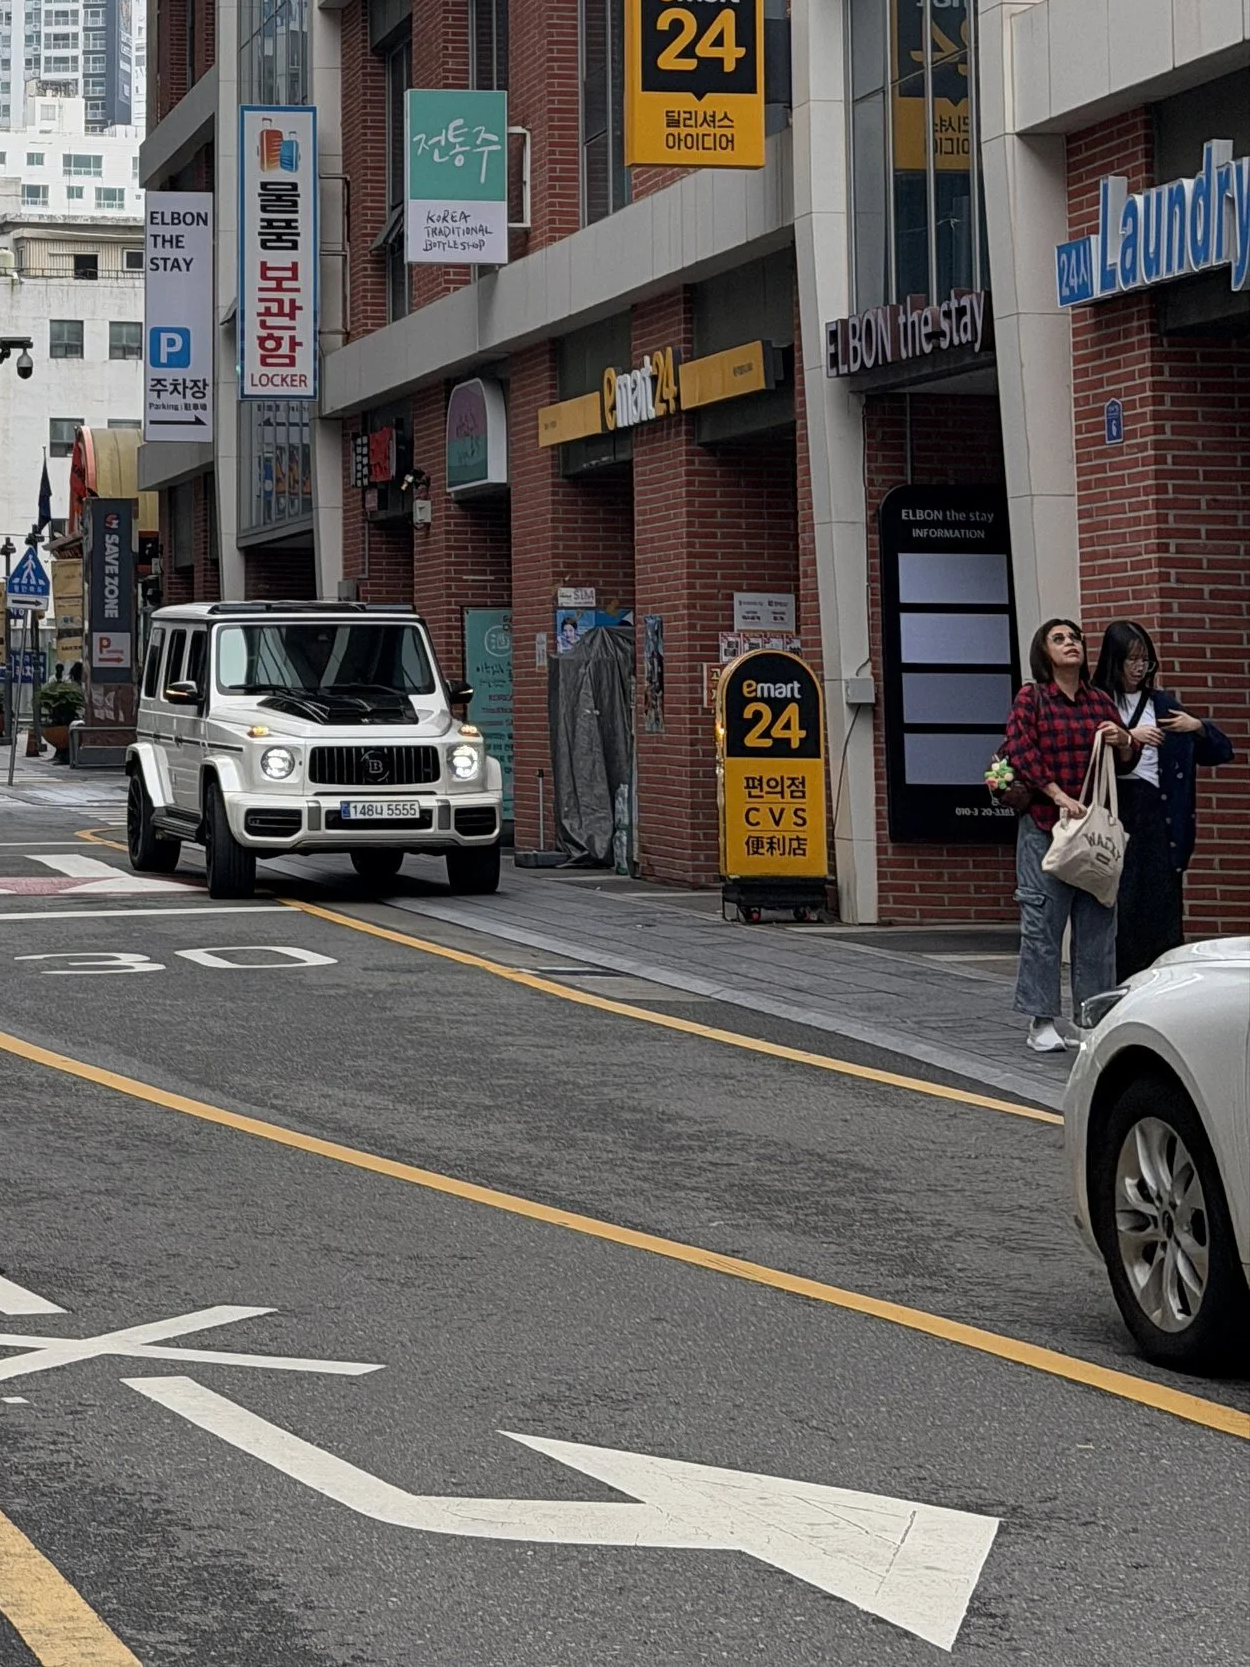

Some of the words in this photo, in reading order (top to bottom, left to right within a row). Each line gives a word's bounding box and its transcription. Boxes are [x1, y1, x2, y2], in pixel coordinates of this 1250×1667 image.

[656, 7, 746, 73] 24
[665, 109, 735, 130] 딜리셔스
[413, 118, 502, 184] 전통주
[665, 133, 735, 152] 아이디어
[150, 210, 209, 226] ELBON
[257, 181, 301, 251] 물품
[426, 209, 471, 224] KOREA
[1059, 240, 1093, 297] 24시
[1099, 139, 1250, 292] Laundry
[150, 233, 186, 249] THE
[424, 225, 493, 238] TRADITIONAL
[149, 257, 194, 272] STAY
[256, 260, 303, 367] 보관함
[825, 303, 892, 378] ELBON
[898, 295, 933, 360] the
[939, 288, 985, 354] stay
[159, 332, 184, 364] P
[149, 377, 209, 400] 주차장
[250, 373, 308, 388] LOCKER
[149, 402, 180, 412] Parking
[901, 508, 943, 521] ELBON
[946, 508, 966, 521] the
[969, 511, 994, 524] stay
[911, 527, 986, 539] INFORMATION
[742, 679, 801, 699] emart
[743, 701, 807, 749] 24
[743, 774, 806, 801] 편의점
[386, 803, 417, 817] 5555
[744, 834, 809, 858] 便利店
[13, 945, 339, 975] 30
